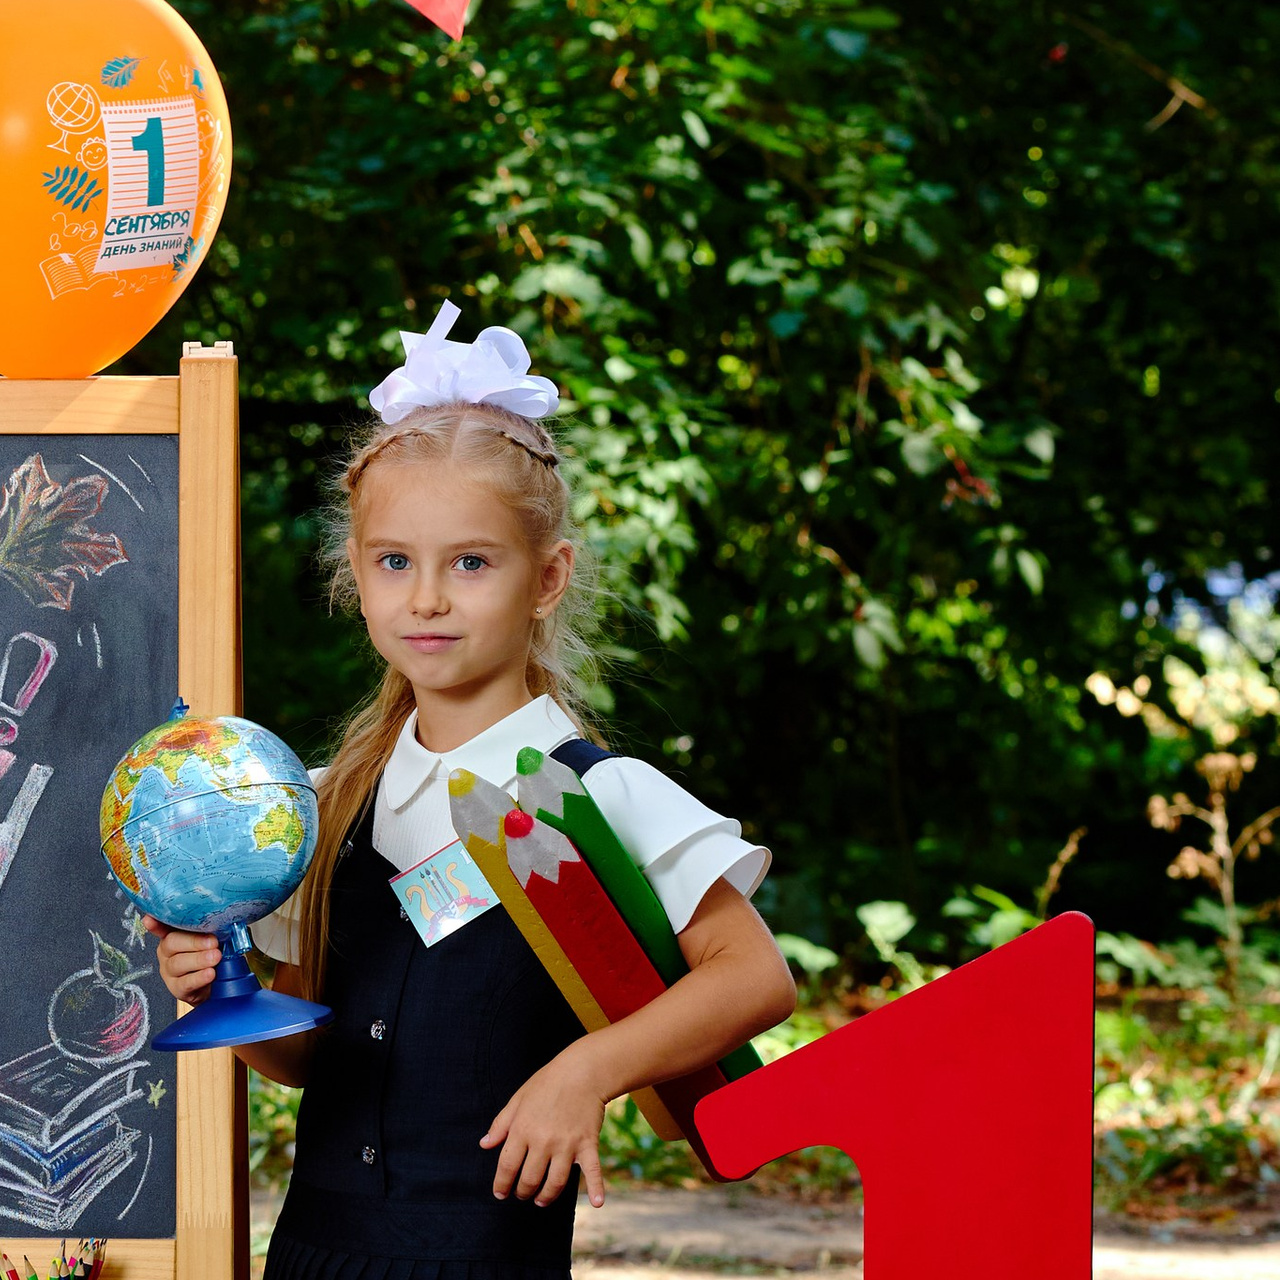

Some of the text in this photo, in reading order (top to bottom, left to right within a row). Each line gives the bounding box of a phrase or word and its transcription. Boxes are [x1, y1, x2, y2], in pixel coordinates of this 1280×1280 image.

[131, 117, 165, 207] 1
[104, 210, 190, 235] СЕНТЯБРЯ
[100, 237, 182, 259] ДЕНЬ ЗНАНИЙ
